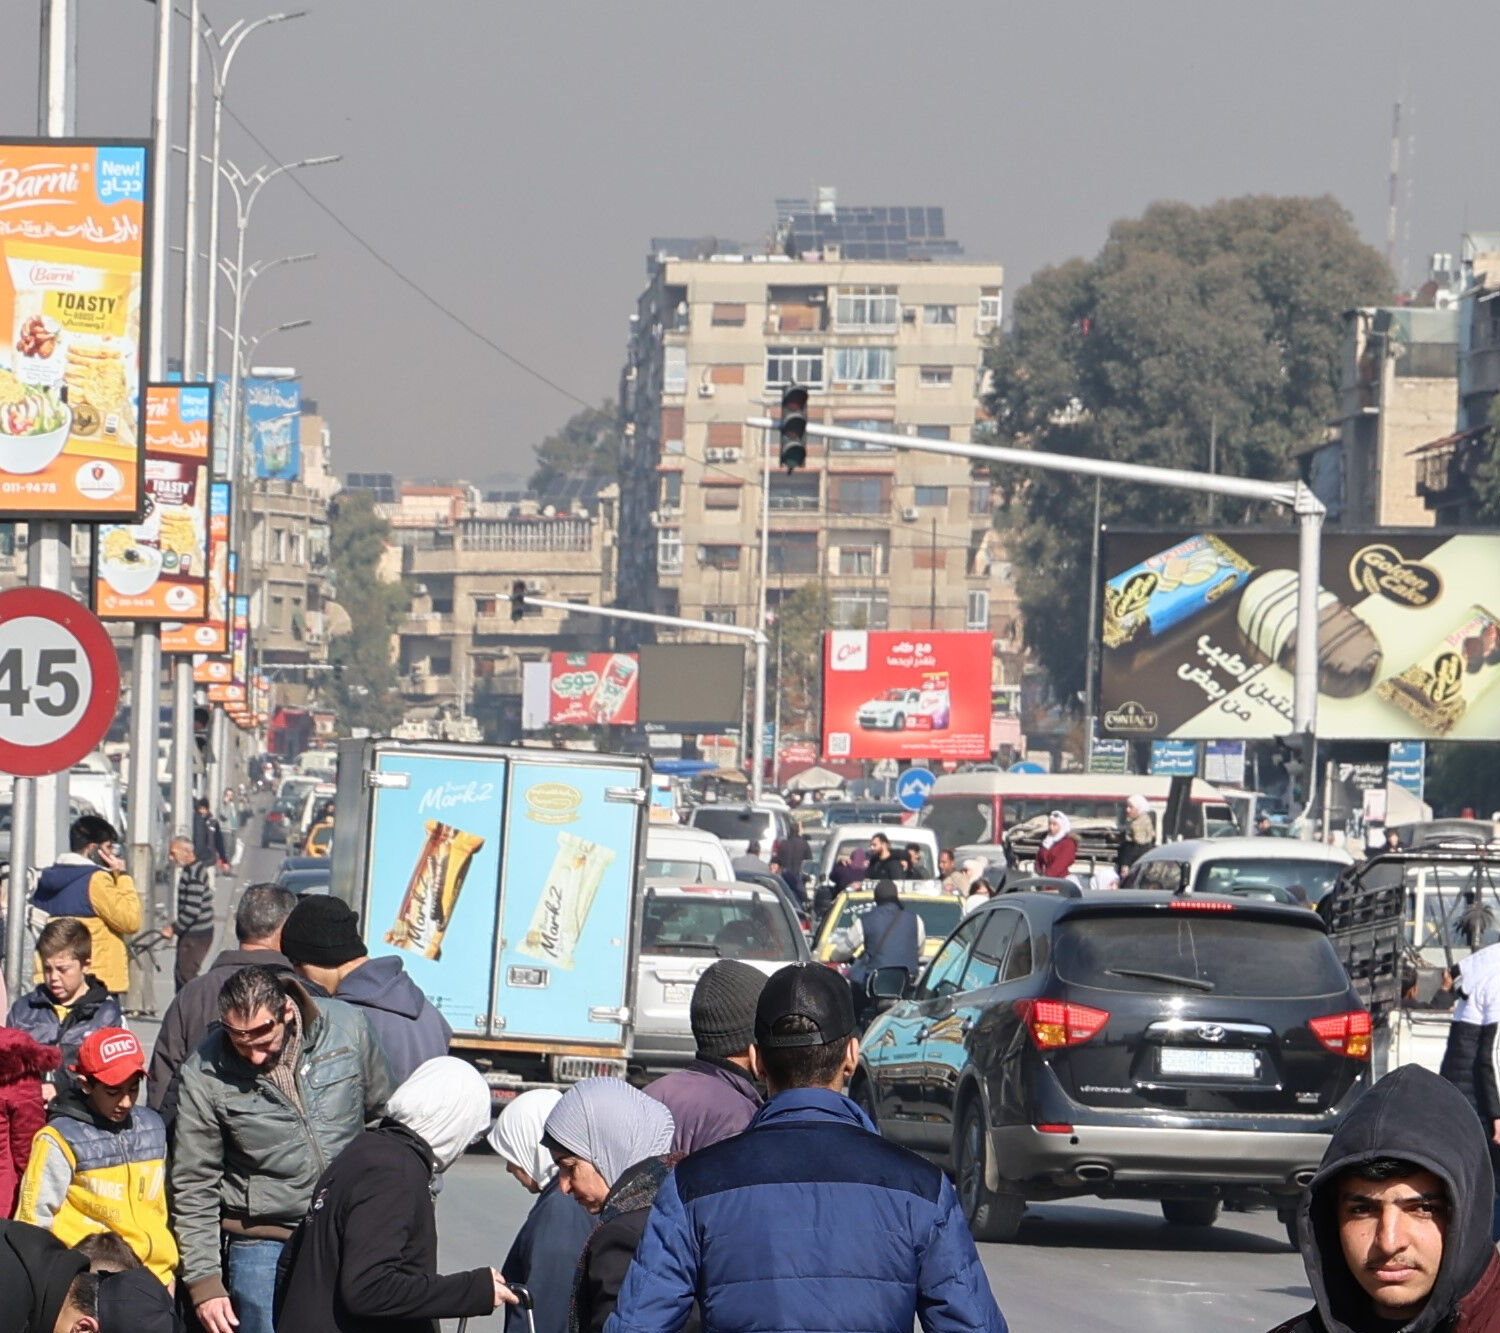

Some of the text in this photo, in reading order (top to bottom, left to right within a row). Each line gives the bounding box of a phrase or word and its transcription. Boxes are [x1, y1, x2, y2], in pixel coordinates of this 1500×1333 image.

[102, 160, 141, 177] New!
[101, 176, 142, 197] دجاج
[34, 267, 75, 283] Barni
[57, 292, 117, 314] TOASTY
[1362, 551, 1429, 592] Golden
[1379, 574, 1428, 604] Cake
[1196, 634, 1264, 683] أطيب
[1177, 662, 1252, 722] من بعض
